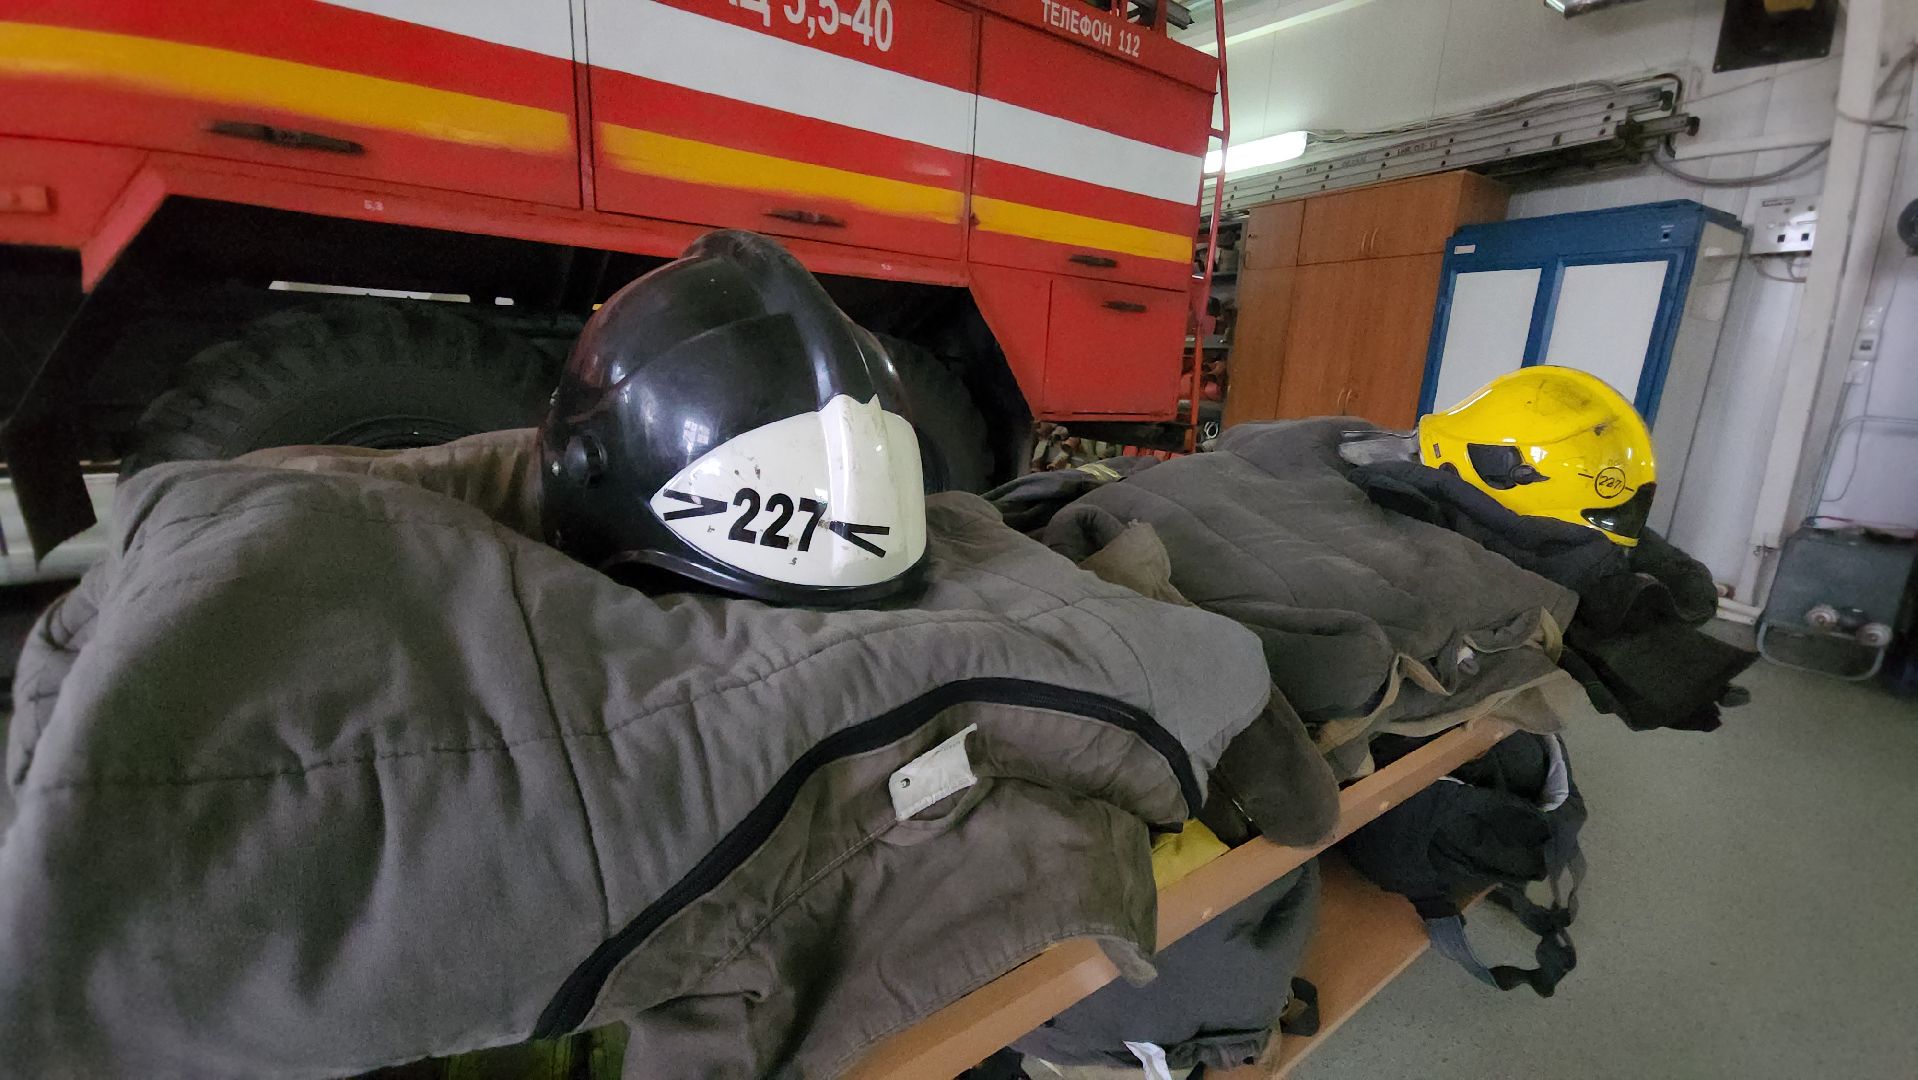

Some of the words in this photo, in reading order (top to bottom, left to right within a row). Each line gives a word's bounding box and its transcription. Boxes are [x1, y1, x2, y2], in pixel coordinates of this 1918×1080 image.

[1042, 0, 1112, 46] ТЕЛЕФОН
[1118, 29, 1140, 58] 112
[1599, 475, 1622, 490] 227
[728, 487, 828, 552] 227
